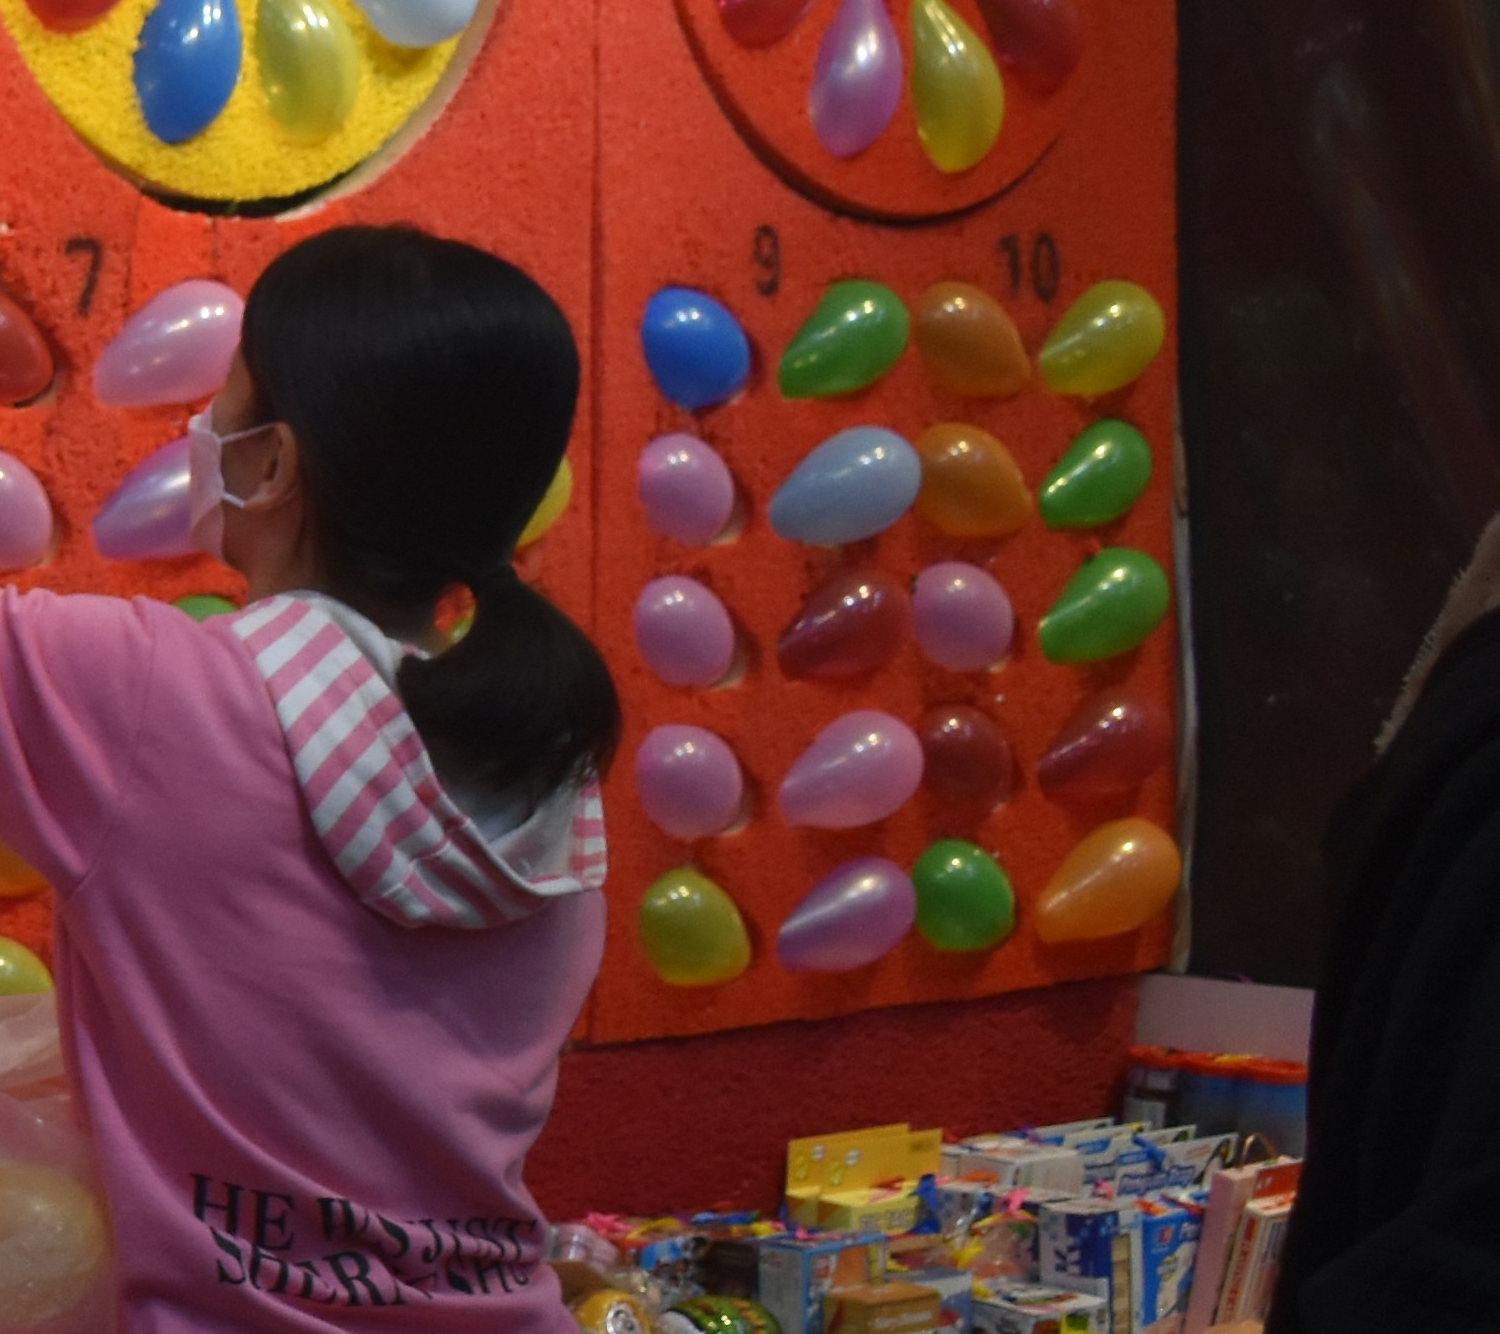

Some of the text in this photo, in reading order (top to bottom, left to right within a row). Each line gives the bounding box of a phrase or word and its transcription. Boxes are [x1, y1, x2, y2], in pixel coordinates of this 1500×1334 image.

[64, 238, 102, 318] 7
[754, 224, 781, 296] 9
[999, 230, 1060, 303] 10
[190, 1173, 295, 1253] HE
